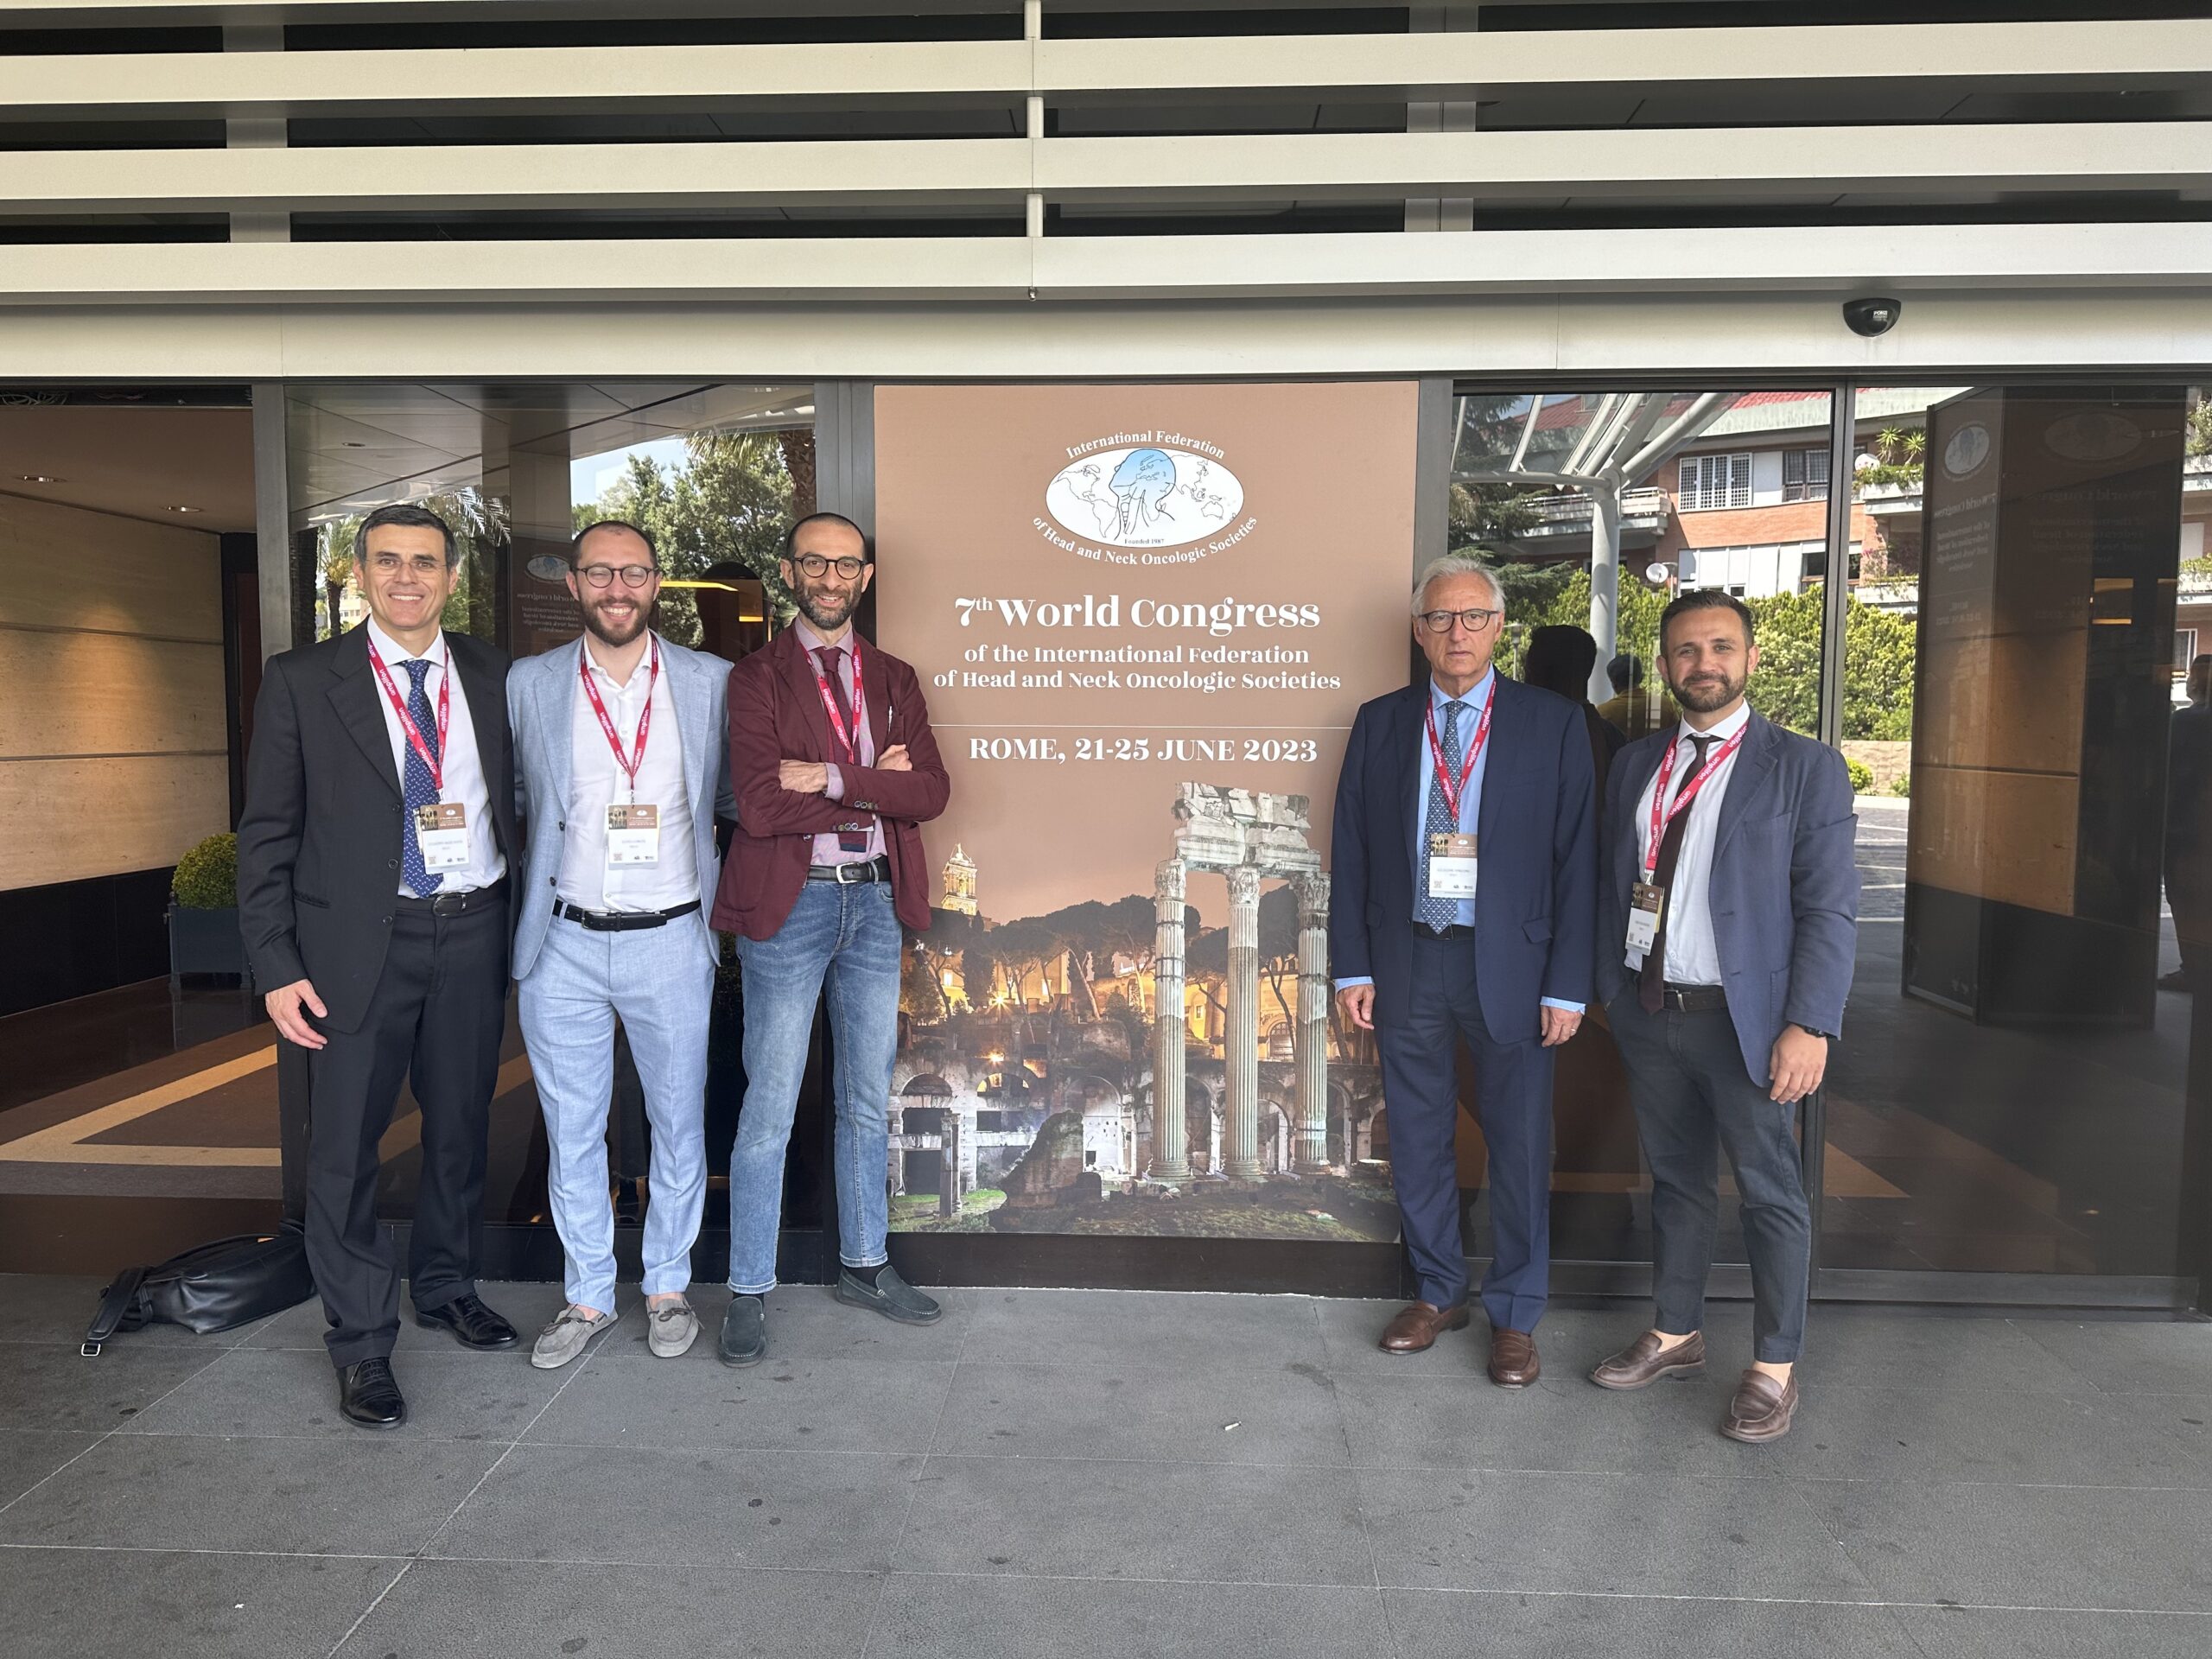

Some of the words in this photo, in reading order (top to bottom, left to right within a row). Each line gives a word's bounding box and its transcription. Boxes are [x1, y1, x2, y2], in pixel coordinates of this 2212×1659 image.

[1065, 430, 1151, 459] International
[1156, 431, 1224, 459] Federation
[1033, 518, 1047, 531] of
[1043, 526, 1075, 551] Head
[1077, 546, 1102, 560] and
[1104, 552, 1137, 565] Neck
[1141, 548, 1207, 564] Oncologic
[1209, 517, 1257, 554] Societies
[956, 597, 993, 626] 7th
[995, 595, 1119, 626] World
[1131, 597, 1319, 637] Congress
[965, 645, 988, 663] of
[993, 645, 1029, 663] the
[1035, 645, 1183, 663] International
[1189, 645, 1309, 664] Federation
[379, 669, 396, 696] amplifon
[934, 670, 957, 687] of
[963, 671, 1017, 688] Head
[1022, 671, 1063, 688] and
[1069, 671, 1121, 689] Neck
[1127, 671, 1236, 693] Oncologic
[1242, 671, 1341, 690] Societies
[398, 707, 416, 735] amplifon
[600, 711, 614, 740] amplifon
[640, 709, 649, 736] amplifon
[1481, 706, 1492, 731] amplifon
[419, 747, 437, 775] amplifon
[969, 739, 1066, 764] ROME,
[1075, 738, 1150, 760] 21-25
[1158, 739, 1236, 761] JUNE
[1243, 739, 1318, 762] 2023
[1433, 742, 1443, 767] amplifon
[1467, 741, 1480, 767] amplifon
[1697, 756, 1721, 780] amplifon
[1655, 783, 1665, 811] amplifon
[1669, 790, 1692, 816] amplifon
